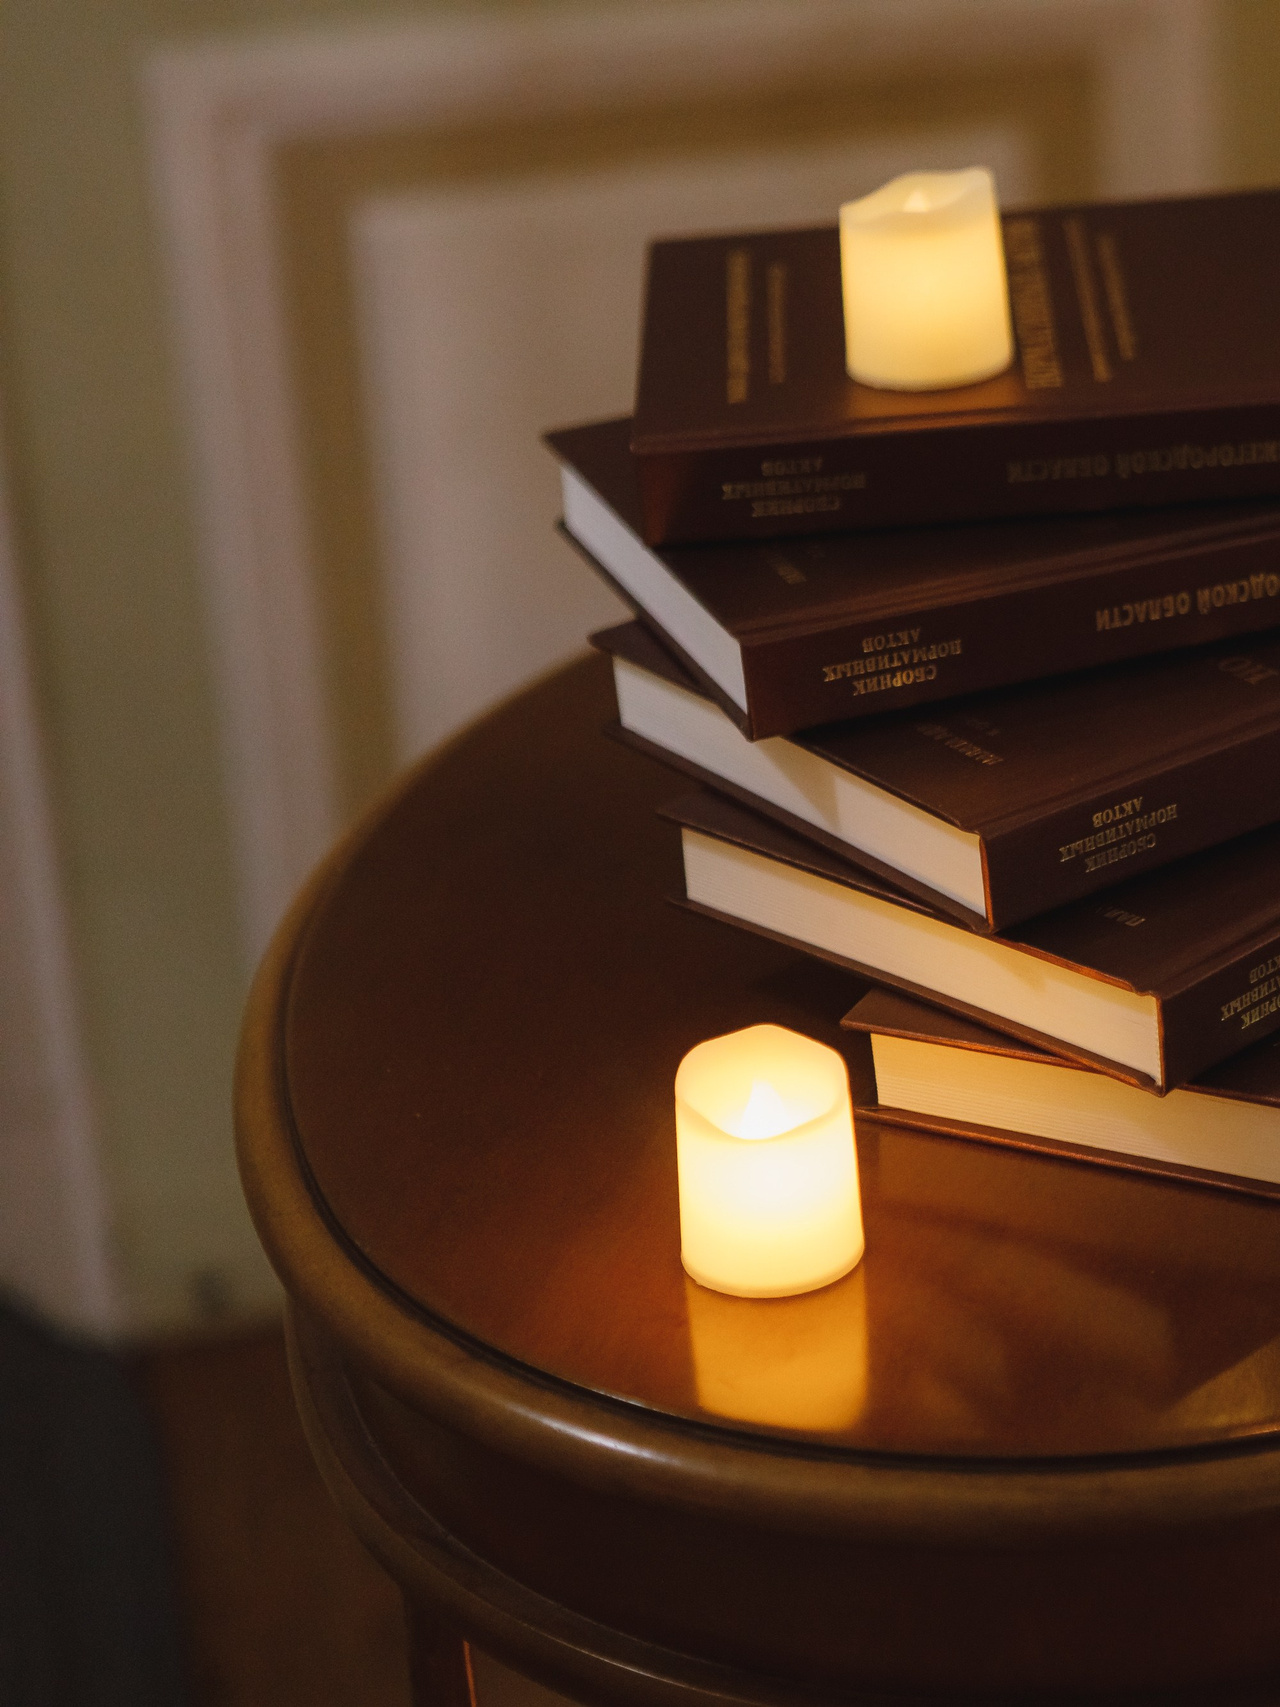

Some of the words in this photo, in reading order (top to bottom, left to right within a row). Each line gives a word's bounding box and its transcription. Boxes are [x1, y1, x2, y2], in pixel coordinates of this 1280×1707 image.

[1095, 592, 1192, 631] ОБЛАСТИ
[861, 627, 921, 653] АКТОВ
[822, 639, 961, 682] НОРМАТИВНЫХ
[852, 664, 937, 696] СБОРНИК
[1092, 796, 1144, 828] АКТОВ
[1058, 803, 1178, 863] НОРМАТИВНЫХ
[1085, 832, 1157, 873] СБОРНИК
